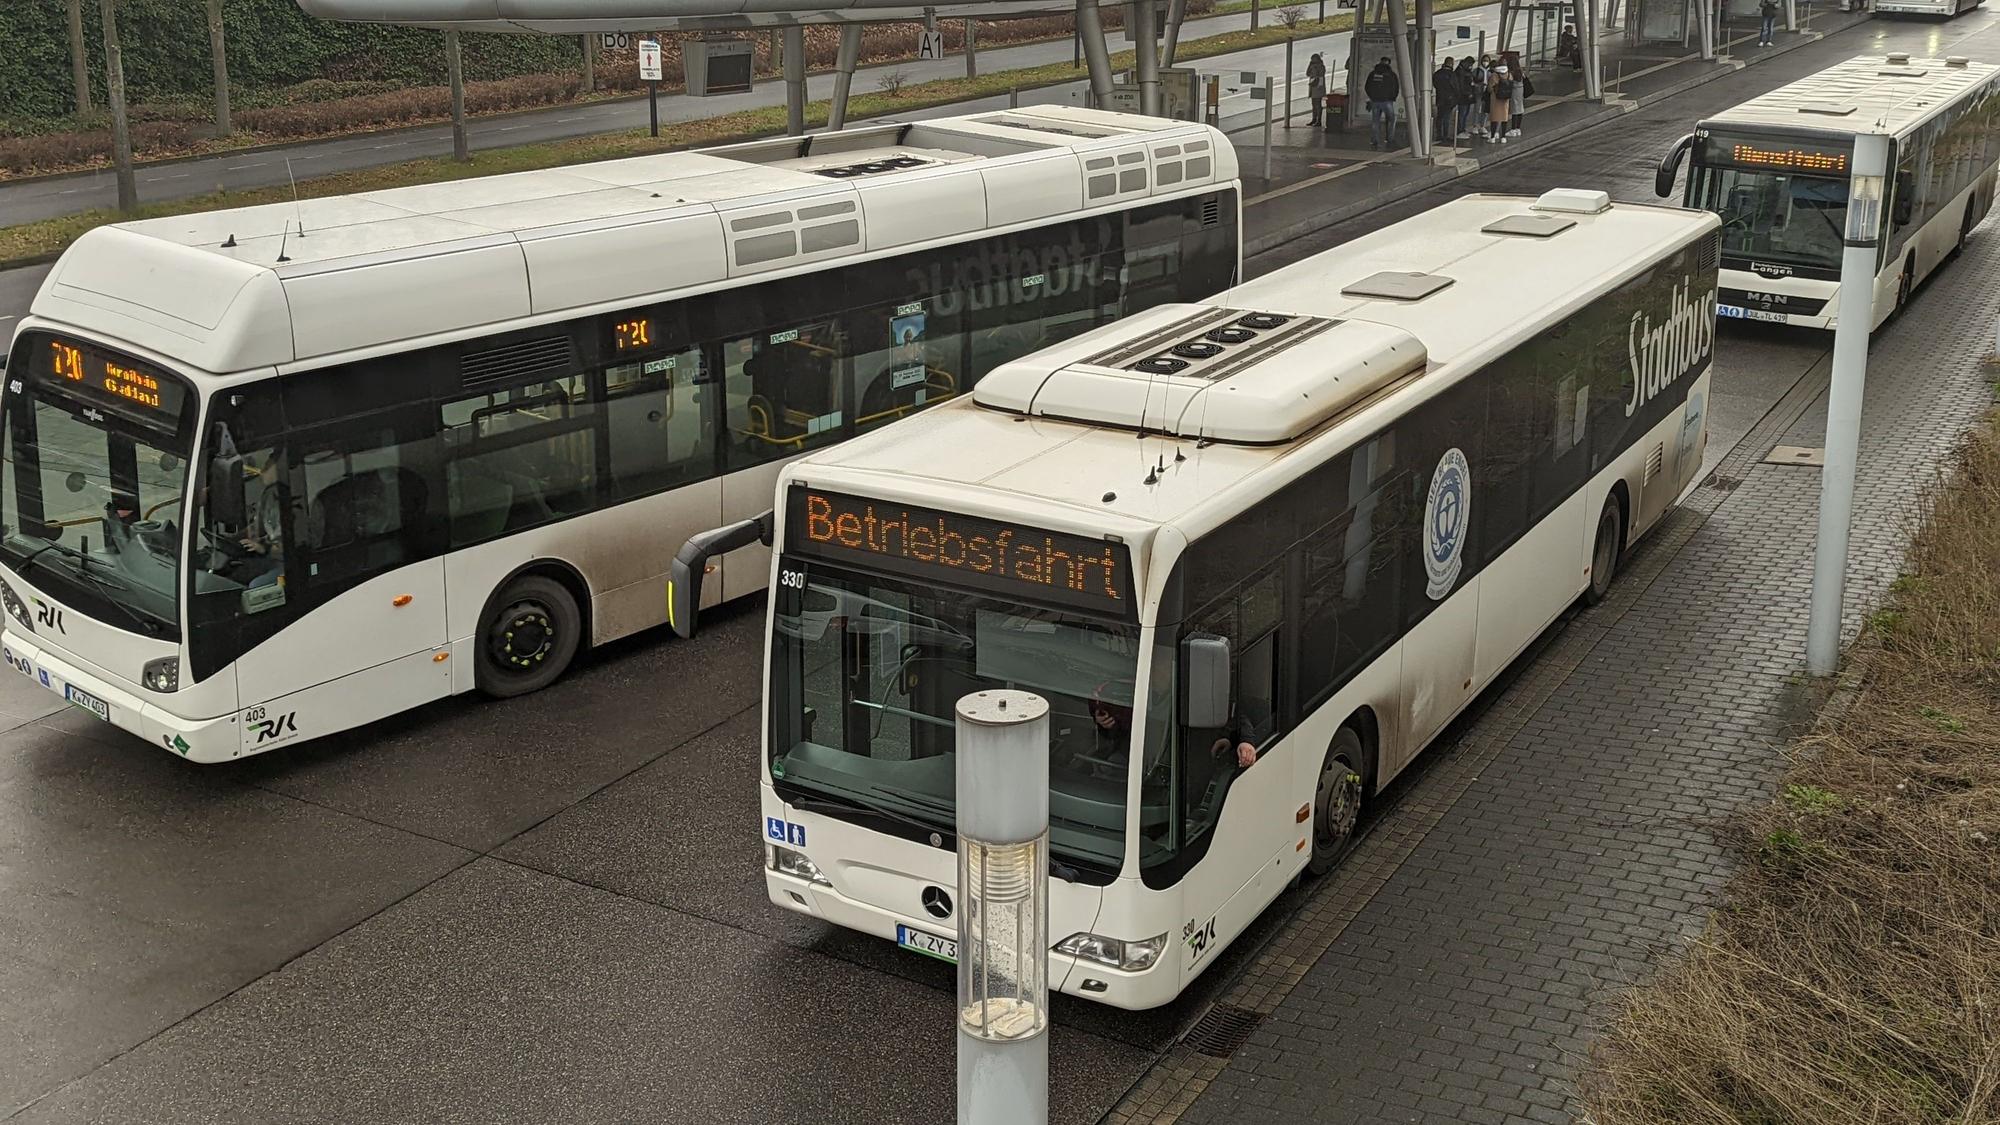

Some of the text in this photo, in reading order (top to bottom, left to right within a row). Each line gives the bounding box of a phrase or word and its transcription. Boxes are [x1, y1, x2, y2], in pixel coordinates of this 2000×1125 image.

[920, 33, 941, 58] A1
[1696, 130, 1709, 138] 419
[1750, 261, 1793, 275] Langen
[1747, 292, 1788, 305] MAN
[1625, 275, 1714, 417] Stadtbus
[9, 379, 23, 395] 403
[807, 495, 1122, 600] Betriebsfahrt
[781, 569, 805, 590] 330
[71, 688, 106, 715] K ZY 403
[245, 707, 266, 722] 403
[1182, 918, 1195, 940] 330
[909, 931, 918, 946] K
[926, 936, 944, 953] ZY
